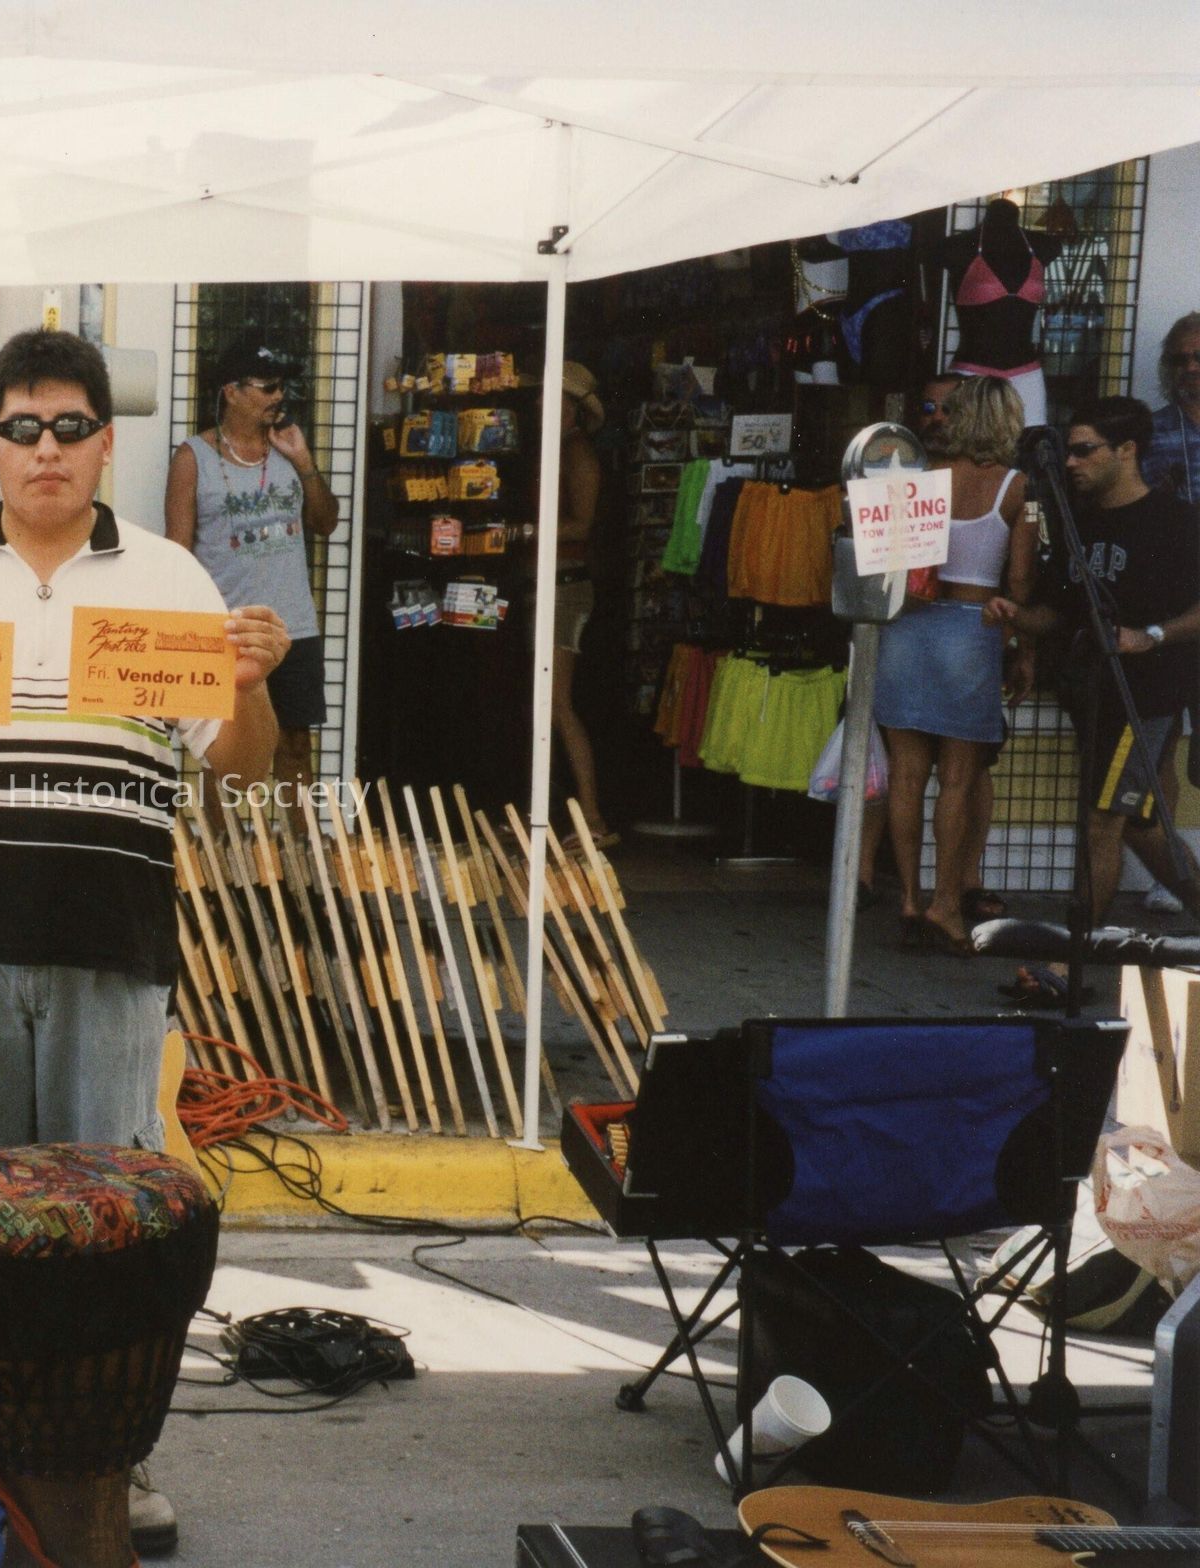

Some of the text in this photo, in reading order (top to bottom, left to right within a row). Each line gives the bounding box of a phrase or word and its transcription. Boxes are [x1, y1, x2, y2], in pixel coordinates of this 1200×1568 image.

[862, 527, 885, 539] TOW
[919, 520, 945, 532] ZONE
[88, 618, 151, 644] Fantasy
[87, 635, 123, 661] Fest
[87, 665, 221, 687] Fri. Vendor I.D.
[132, 686, 166, 708] 311
